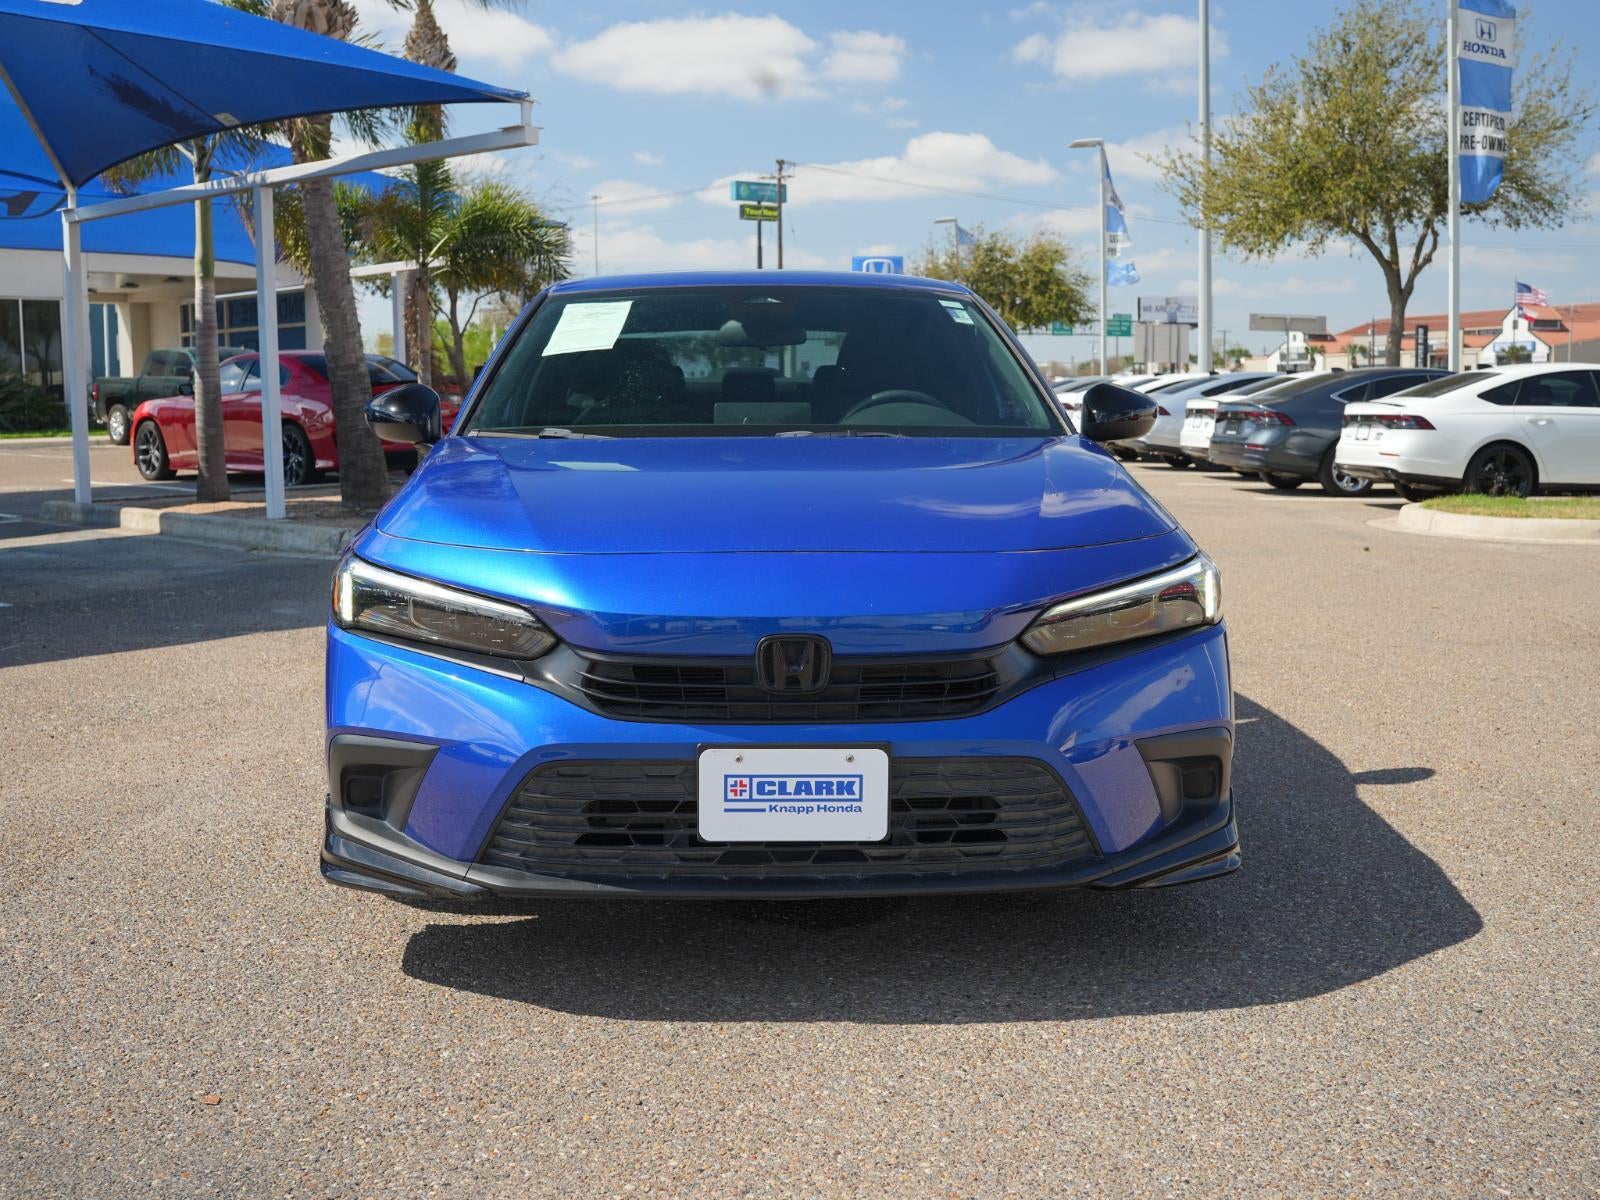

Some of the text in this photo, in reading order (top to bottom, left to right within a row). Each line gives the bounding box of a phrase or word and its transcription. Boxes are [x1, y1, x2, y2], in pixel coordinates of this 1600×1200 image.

[1463, 40, 1506, 59] HONDA
[756, 780, 856, 796] CLARK
[769, 804, 862, 815] Knapp Honda
